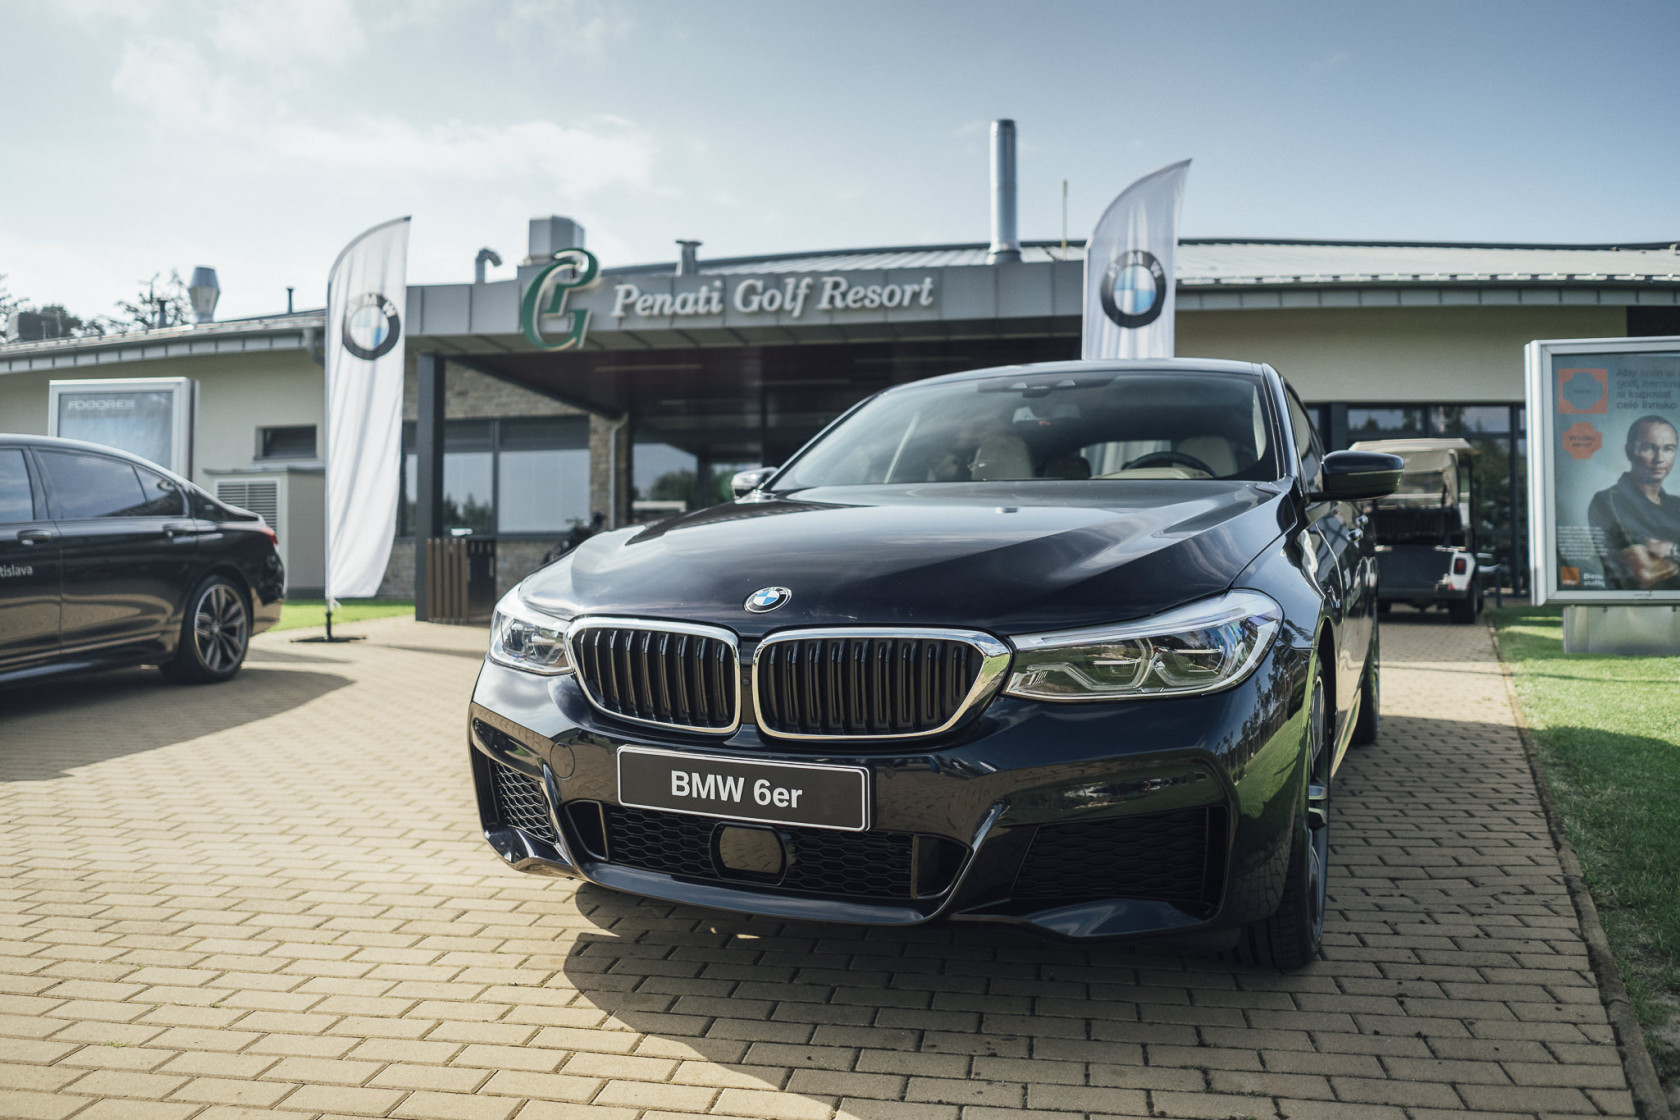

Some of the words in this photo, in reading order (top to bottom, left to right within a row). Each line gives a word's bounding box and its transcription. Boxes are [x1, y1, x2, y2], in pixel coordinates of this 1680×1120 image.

[611, 279, 724, 318] Penati
[735, 276, 812, 318] Golf
[817, 275, 934, 310] Resort
[671, 769, 745, 803] BMW
[753, 778, 803, 809] 6er
